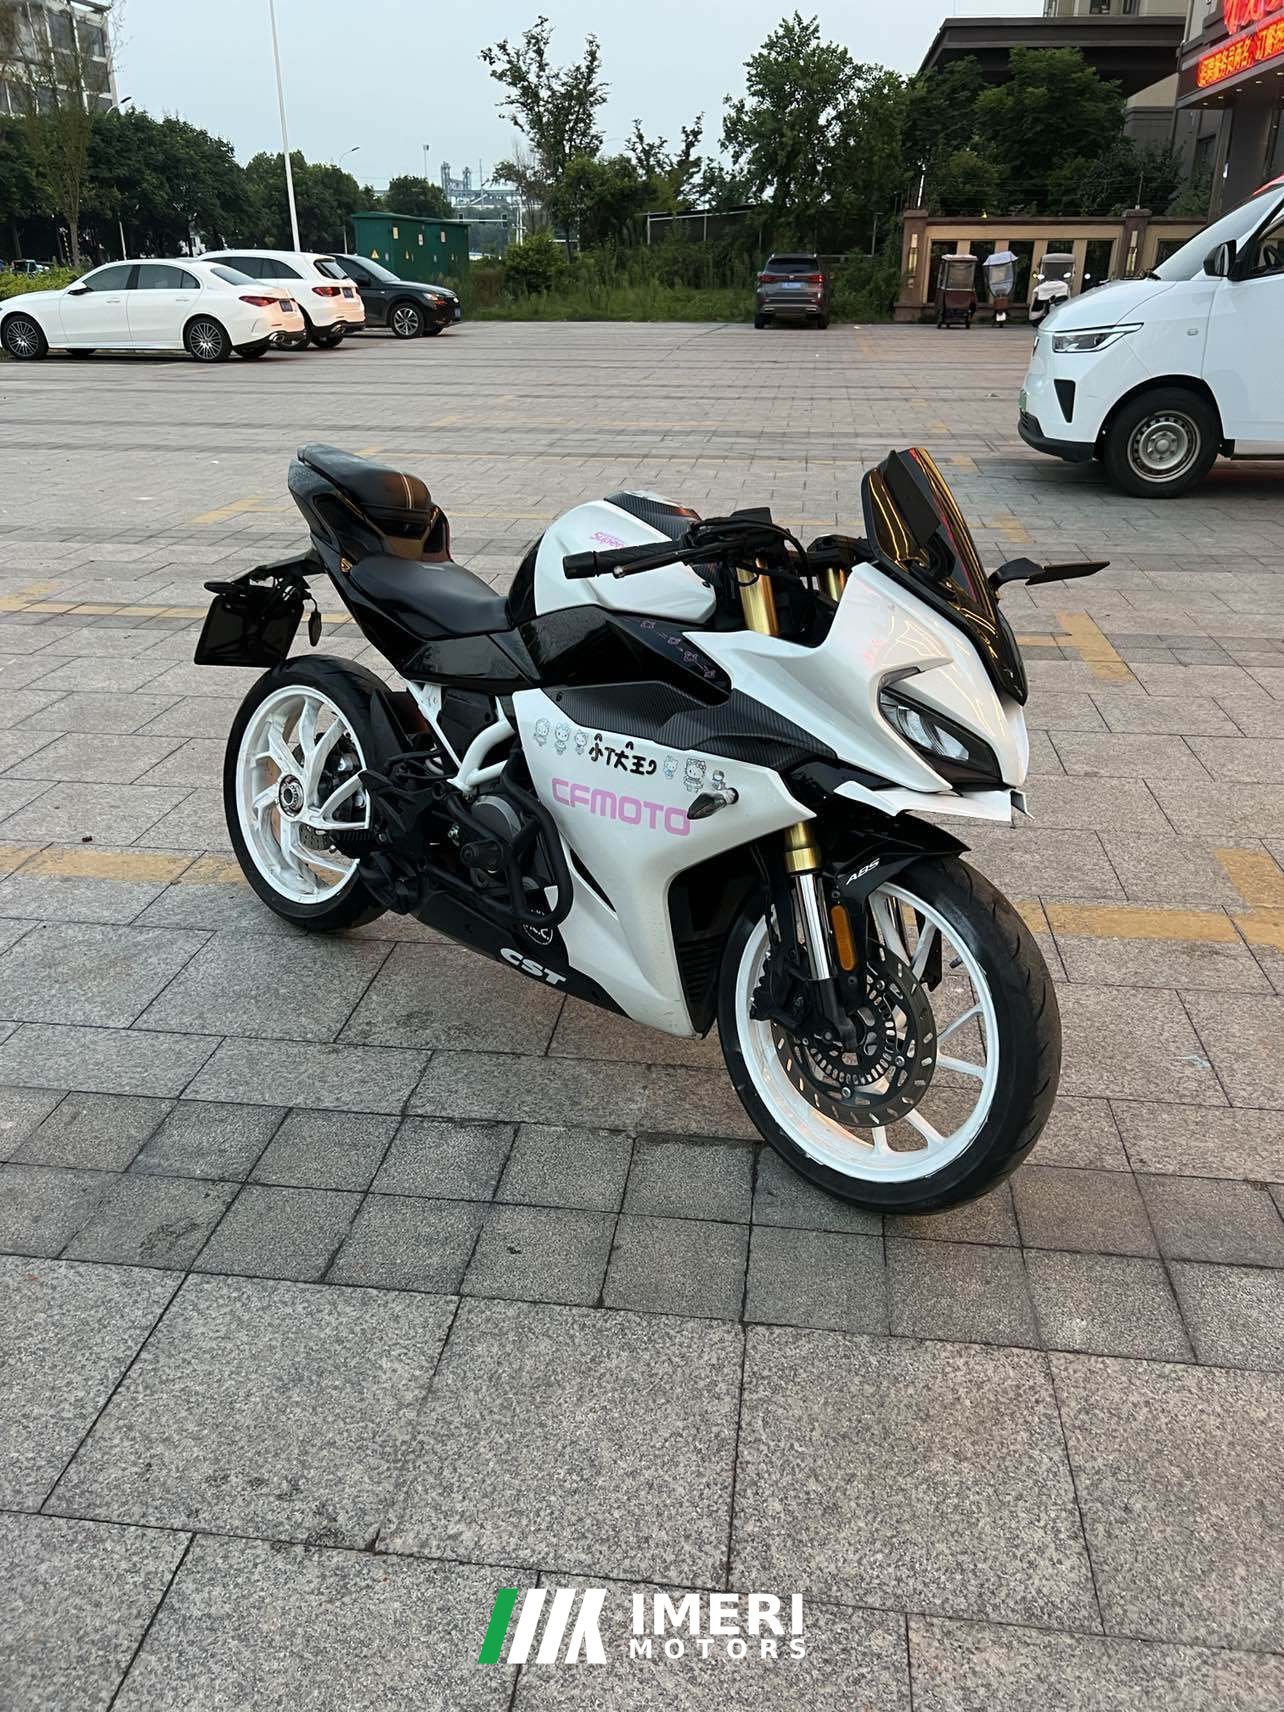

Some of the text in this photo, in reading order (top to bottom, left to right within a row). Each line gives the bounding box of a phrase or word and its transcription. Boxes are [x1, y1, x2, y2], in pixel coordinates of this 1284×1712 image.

[551, 777, 691, 836] CFMOTO
[846, 857, 880, 885] ABS
[500, 947, 567, 985] CST
